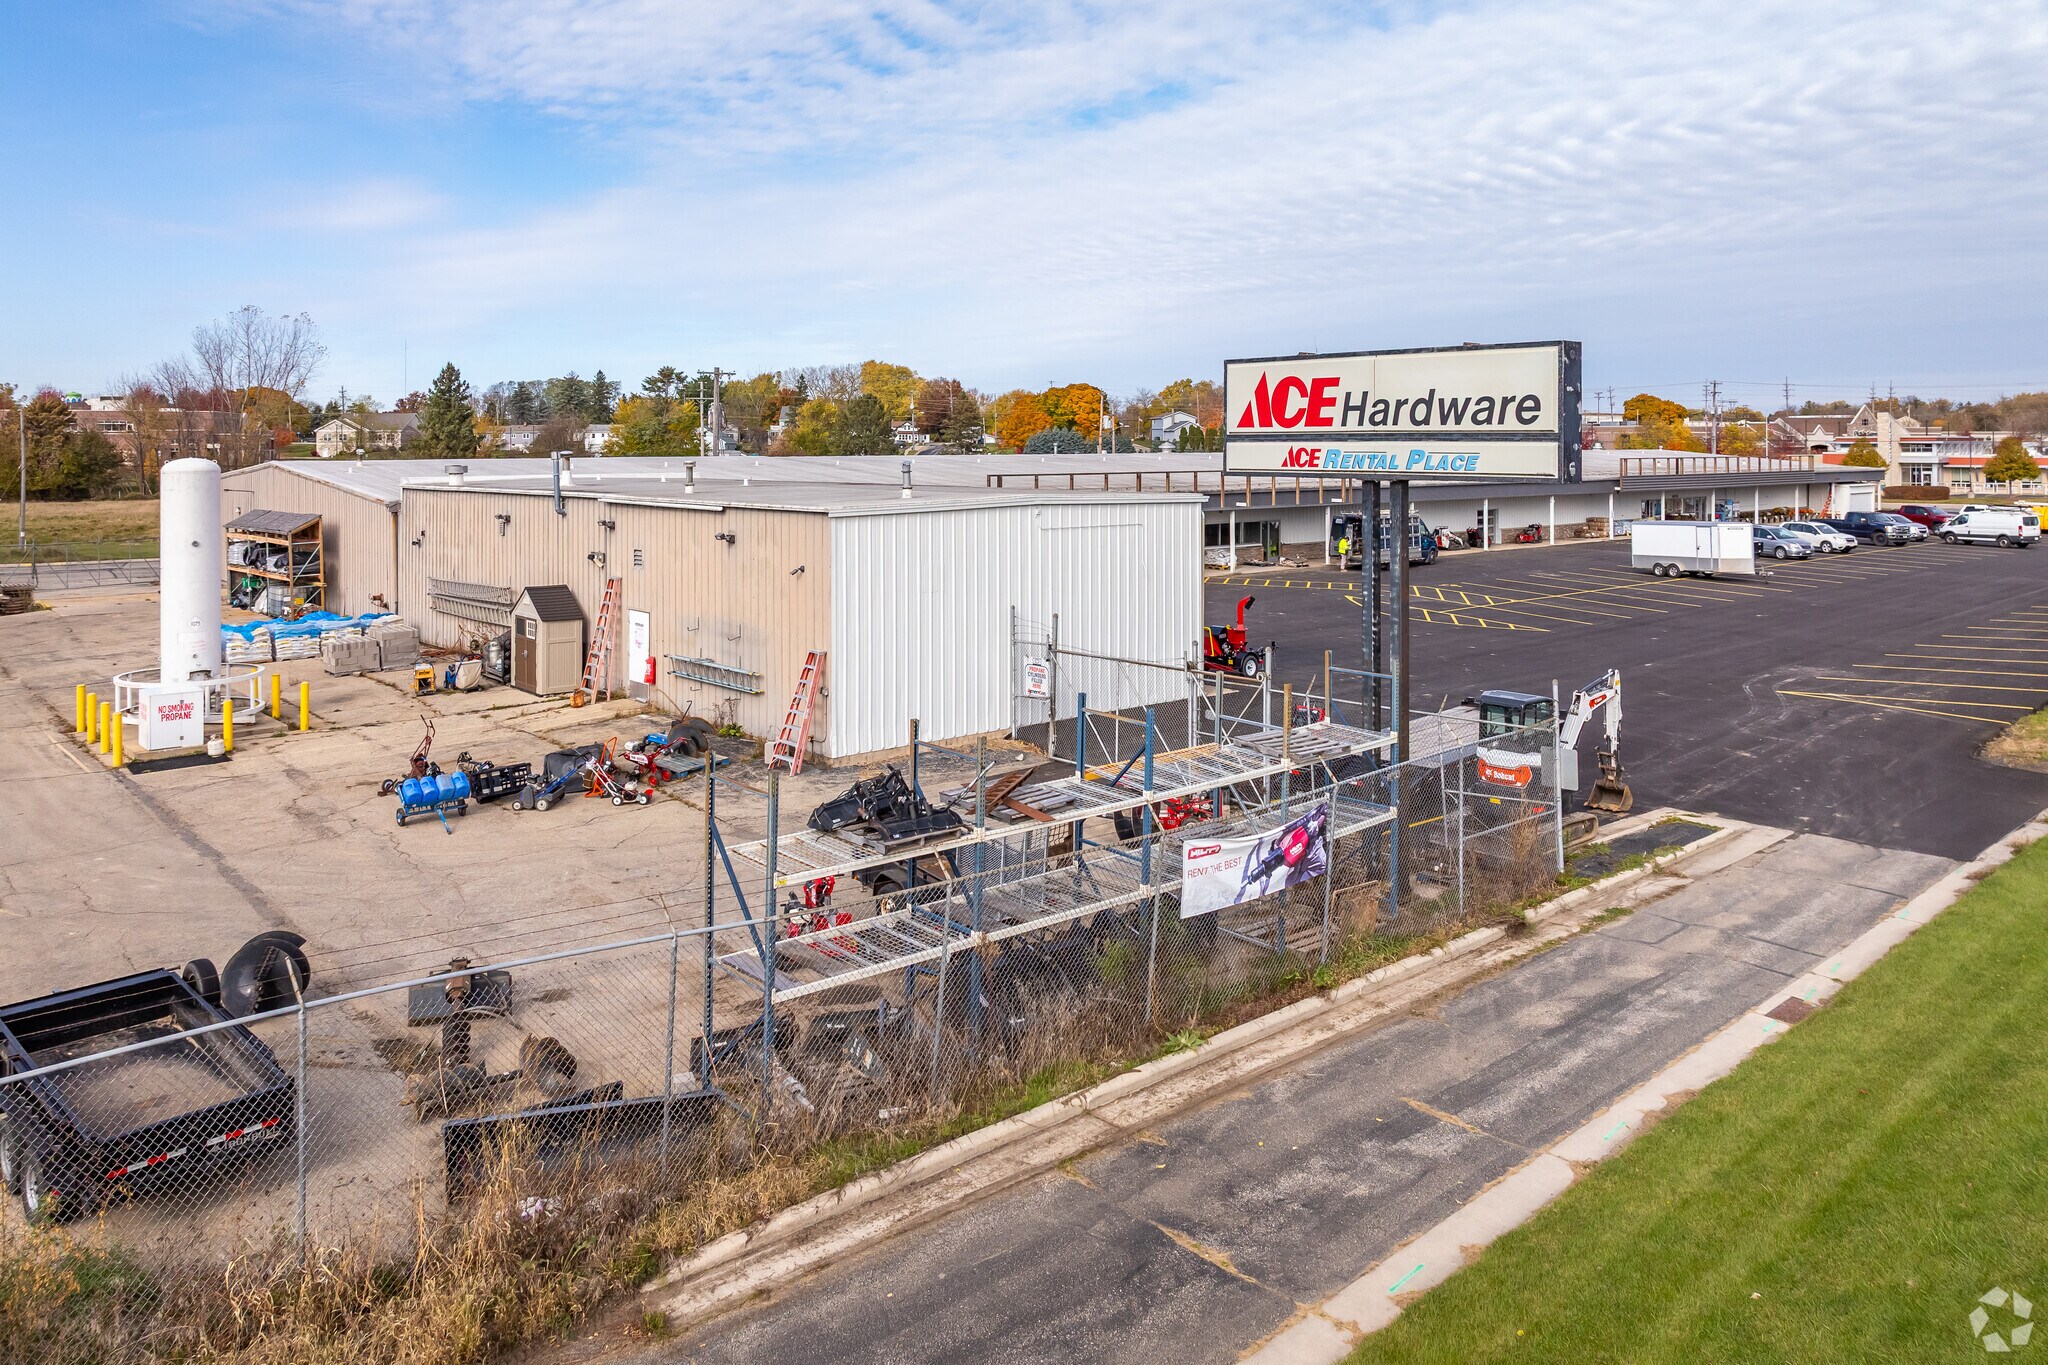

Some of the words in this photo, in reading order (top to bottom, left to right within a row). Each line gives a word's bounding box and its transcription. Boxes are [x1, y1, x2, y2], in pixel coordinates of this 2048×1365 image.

[1236, 371, 1340, 428] ACE
[1341, 389, 1541, 427] Hardware
[1281, 446, 1321, 468] ACE
[1323, 449, 1399, 470] RENTAL
[1406, 449, 1480, 471] PLACE
[158, 705, 167, 714] NO
[168, 703, 194, 712] SMOKING
[161, 711, 192, 722] PROPANE
[1190, 845, 1220, 858] HILTI
[1187, 866, 1208, 879] RENT
[1211, 862, 1223, 873] THE
[1224, 856, 1242, 869] BEST
